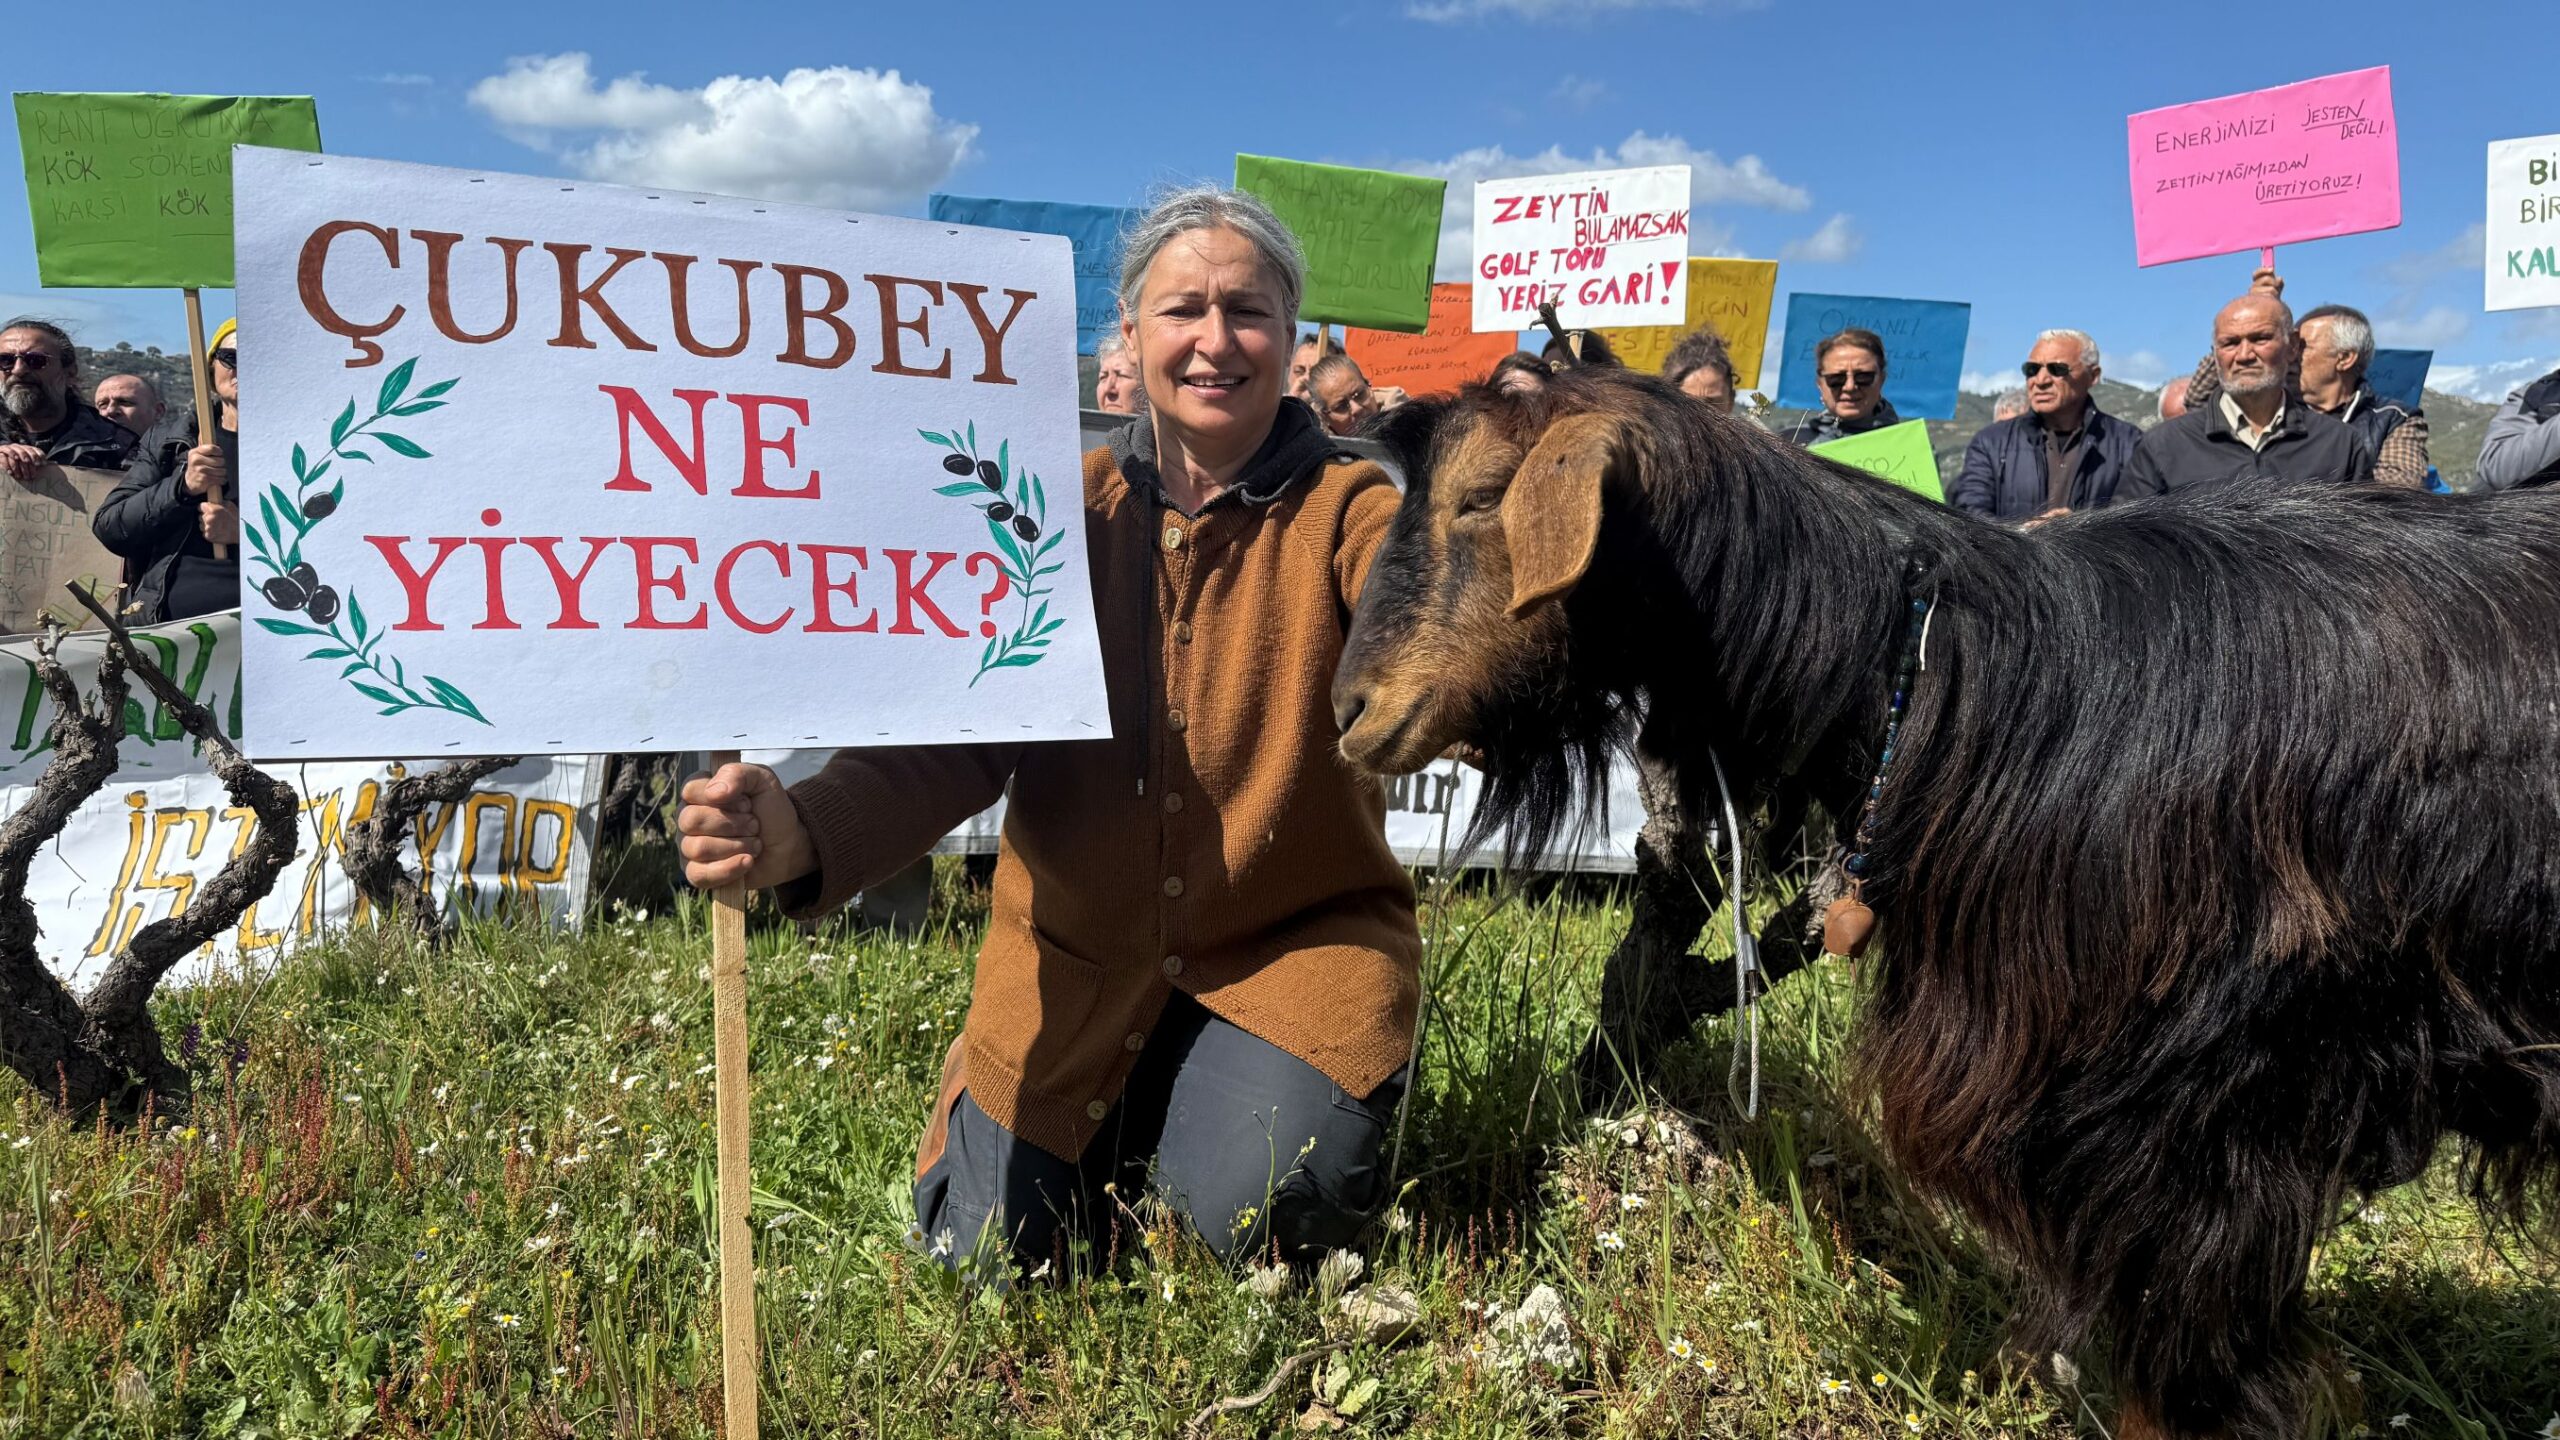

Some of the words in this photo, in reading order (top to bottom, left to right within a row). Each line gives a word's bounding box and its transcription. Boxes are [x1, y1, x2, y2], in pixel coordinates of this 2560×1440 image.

[34, 107, 112, 145] RANT
[2301, 99, 2366, 127] JESTEN
[42, 150, 102, 187] KÖK
[51, 195, 127, 226] KARŞI
[159, 188, 211, 217] KÖK
[1492, 186, 1609, 225] ZEYTİN
[1574, 209, 1689, 247] BULAMAZSAK
[1480, 250, 1539, 280] GOLF
[1550, 246, 1607, 274] TOPU
[297, 219, 1038, 386] ÇUKUBEY
[1498, 279, 1568, 312] YERİZ
[598, 385, 822, 500] NE
[363, 508, 1011, 639] YİYECEK?
